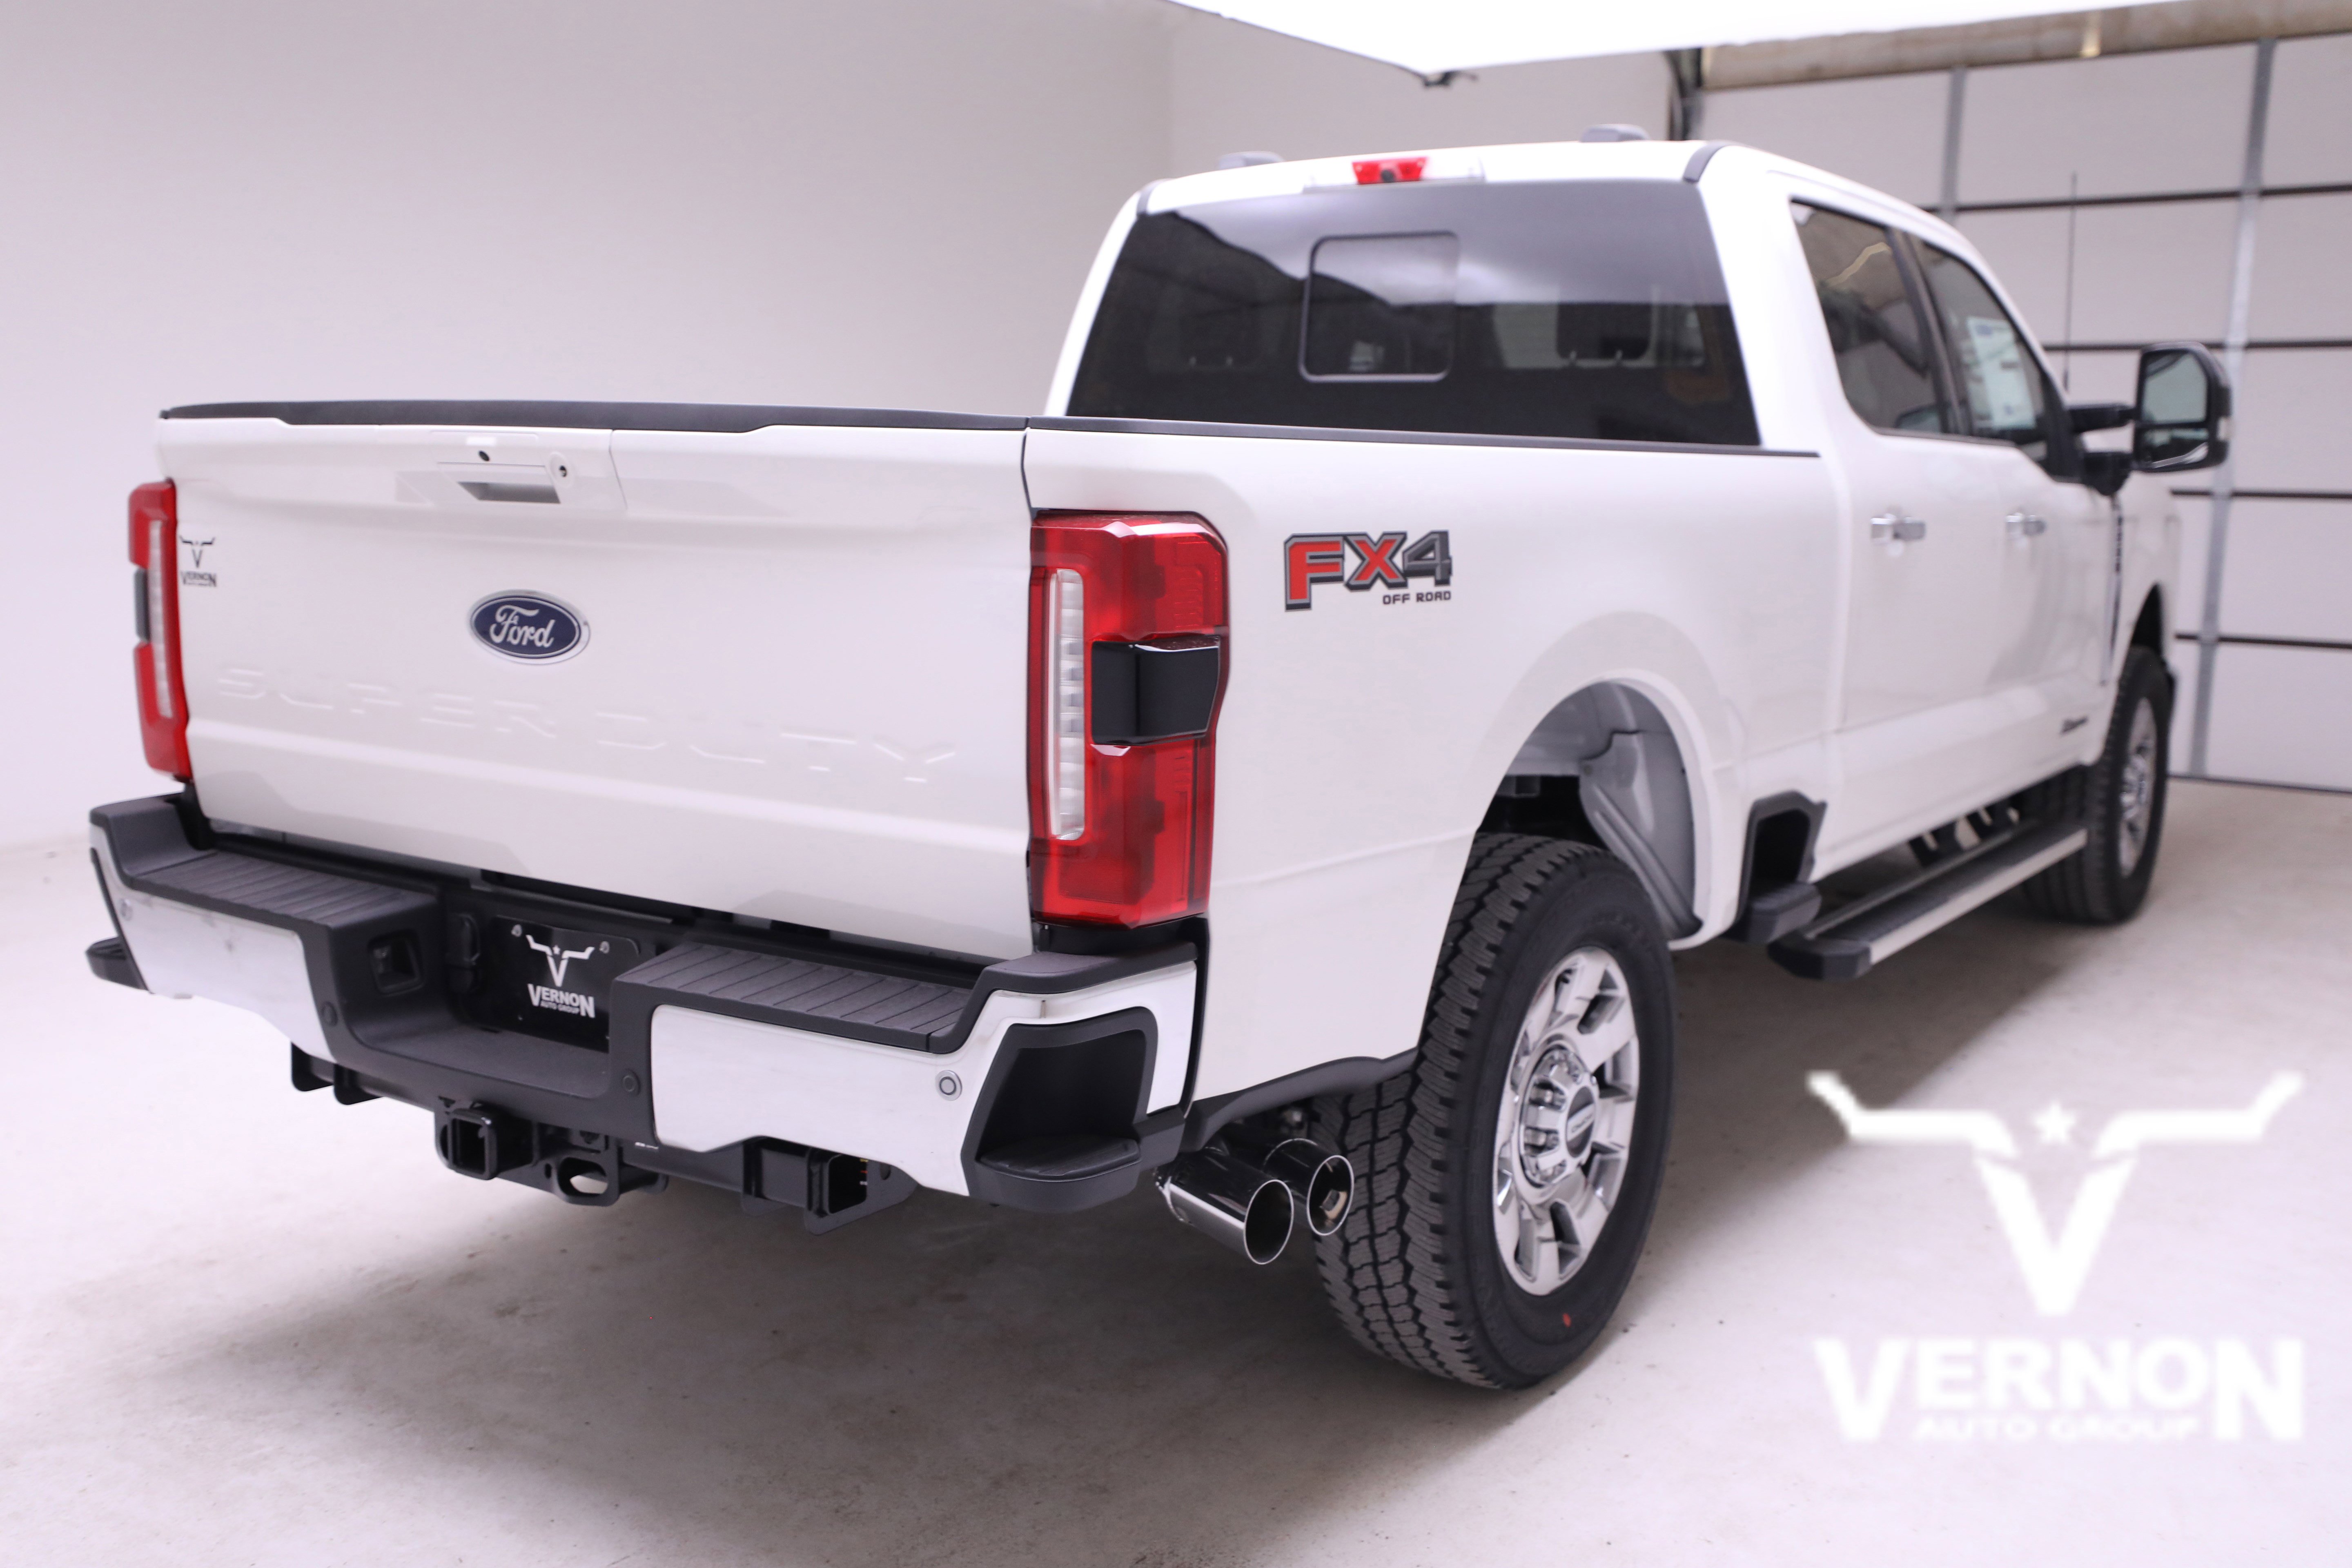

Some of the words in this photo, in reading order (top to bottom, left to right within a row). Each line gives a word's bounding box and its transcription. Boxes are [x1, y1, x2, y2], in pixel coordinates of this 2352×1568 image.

[1284, 530, 1452, 612] FX4
[1383, 593, 1410, 605] OFF
[1416, 590, 1451, 603] ROAD
[490, 604, 555, 648] Ford
[218, 662, 557, 738] SUPER
[595, 706, 956, 784] DUTY
[527, 983, 595, 1018] VERNON
